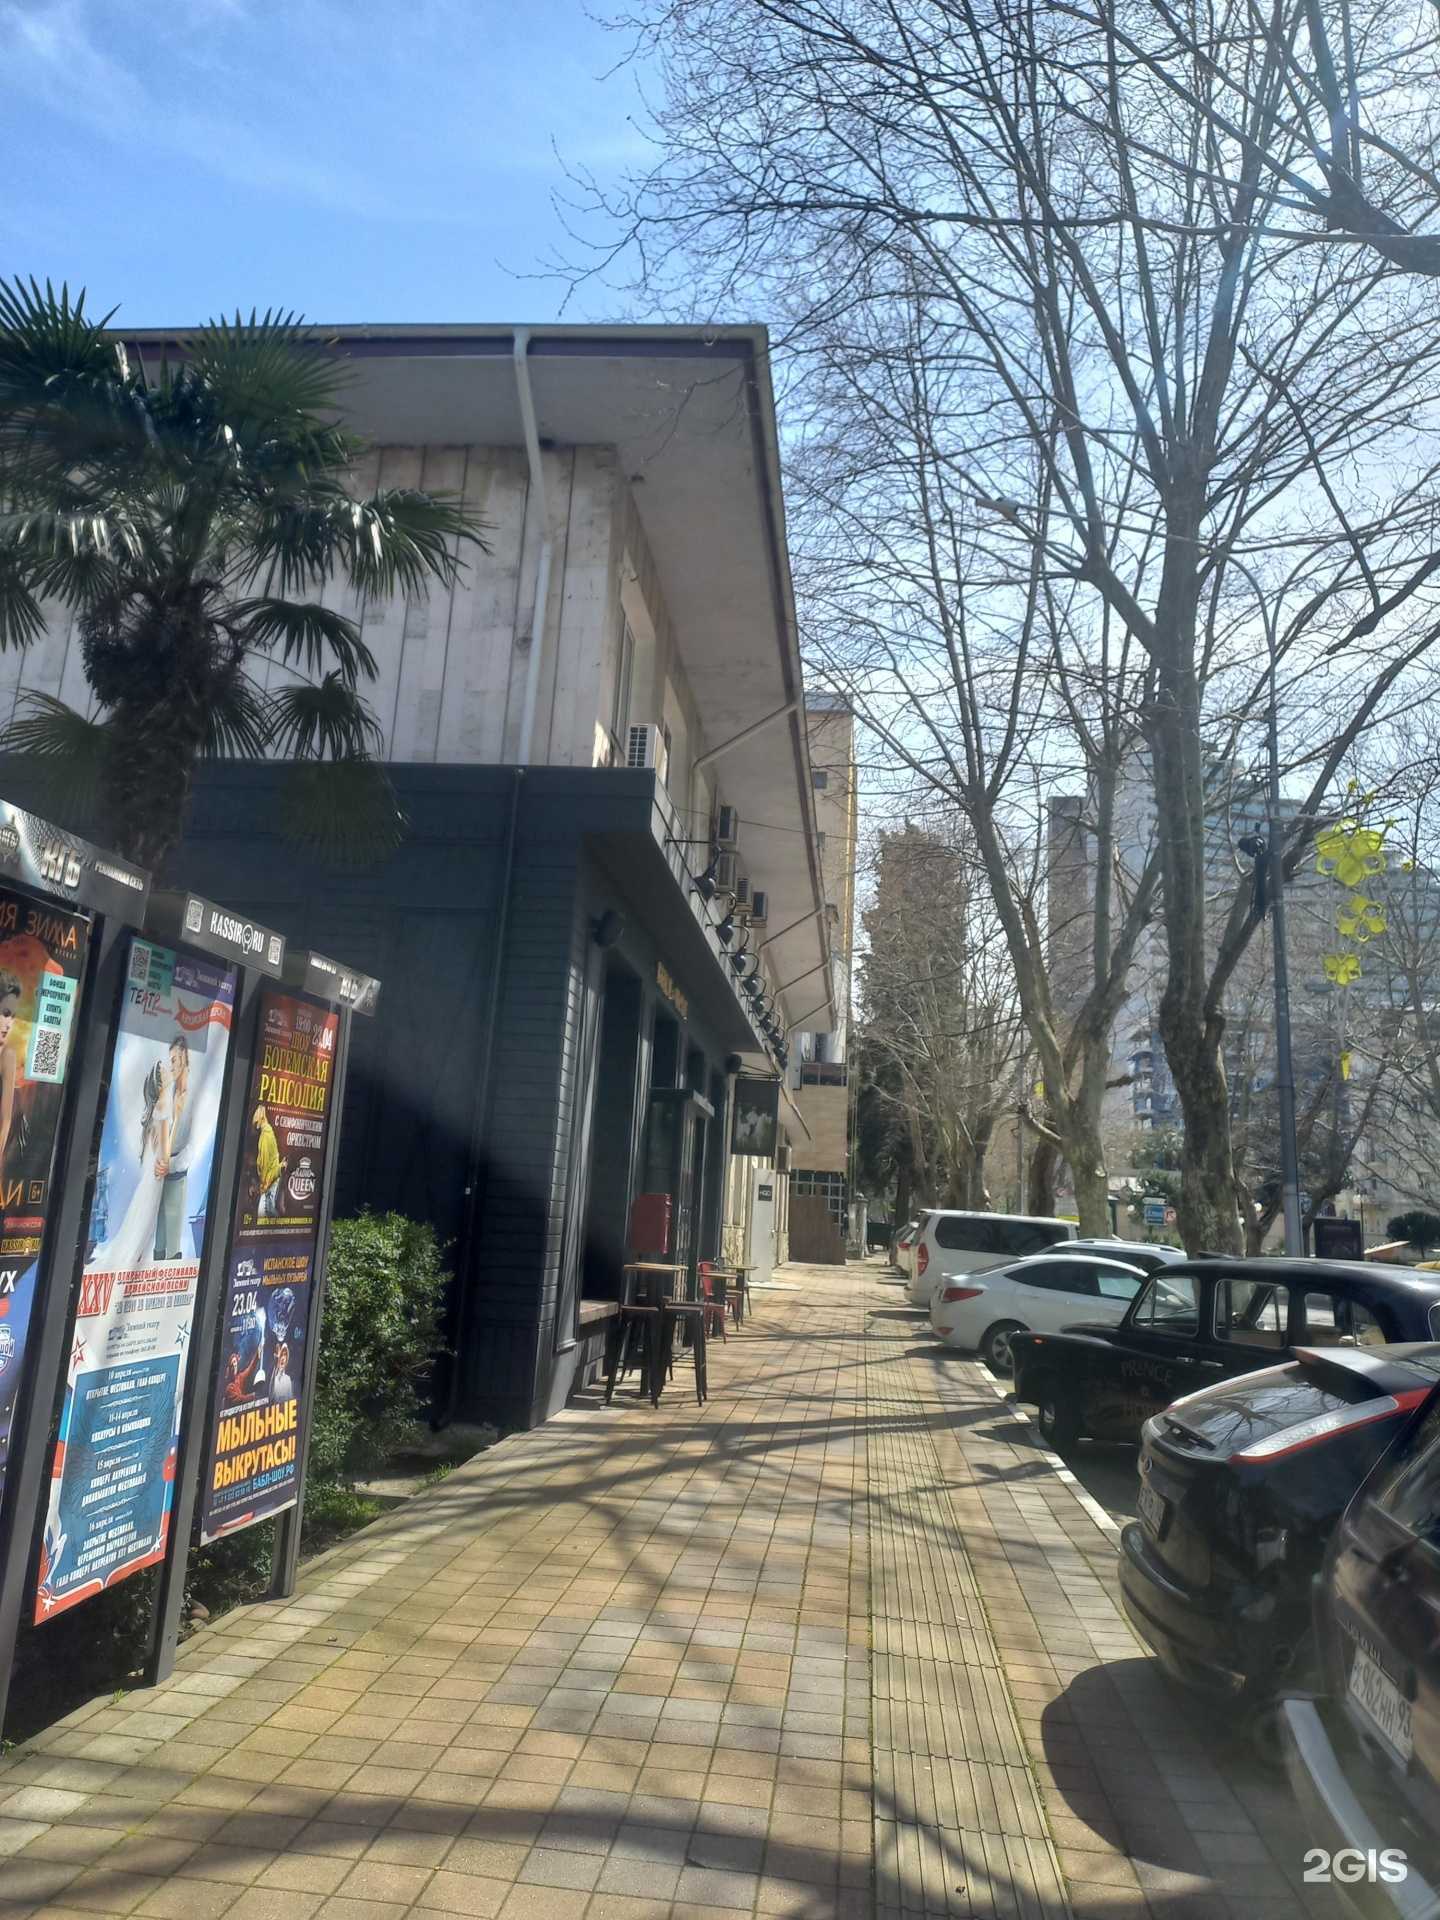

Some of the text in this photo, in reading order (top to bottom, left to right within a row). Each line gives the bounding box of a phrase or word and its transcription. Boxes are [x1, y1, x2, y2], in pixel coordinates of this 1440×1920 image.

[263, 1044, 329, 1083] БОГЕМСКАЯ
[258, 1074, 326, 1112] РАПСОДИЯ
[287, 1176, 316, 1193] QUEEN
[117, 1266, 199, 1283] ОТКРЫТЫЙ ФЕСТИВАЛЬ
[77, 1273, 115, 1317] XXV
[232, 1291, 258, 1317] 23.04
[215, 1399, 297, 1455] МЫЛЬНЫЕ
[213, 1436, 297, 1490] ВЫКРУТАСЫ!
